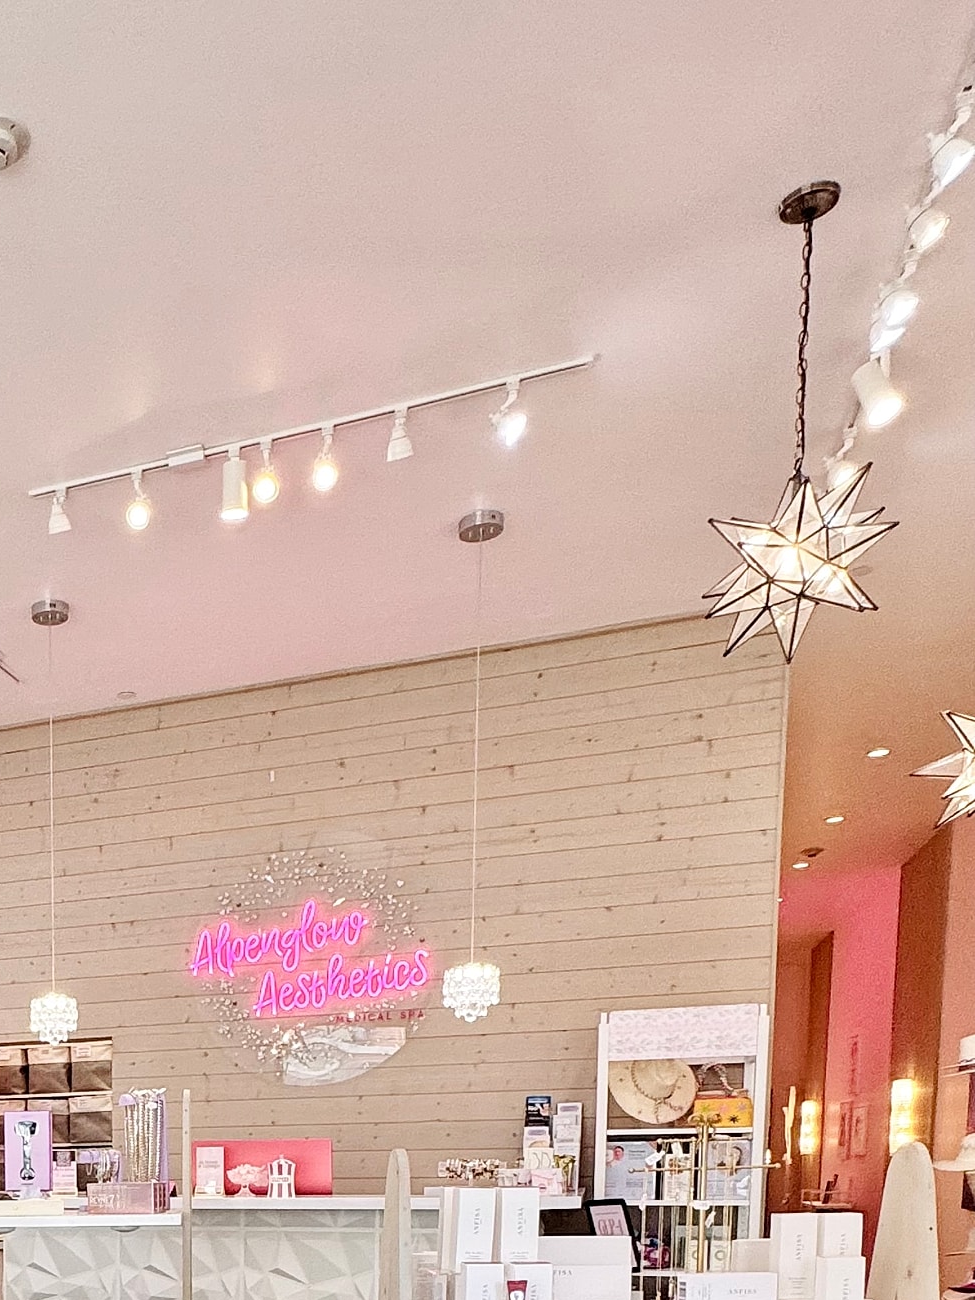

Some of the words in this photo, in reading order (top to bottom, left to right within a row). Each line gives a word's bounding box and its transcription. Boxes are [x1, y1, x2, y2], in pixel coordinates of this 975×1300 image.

[190, 900, 367, 977] Alpenglow
[253, 950, 429, 1017] Aesthetics
[400, 1010, 424, 1020] SPA
